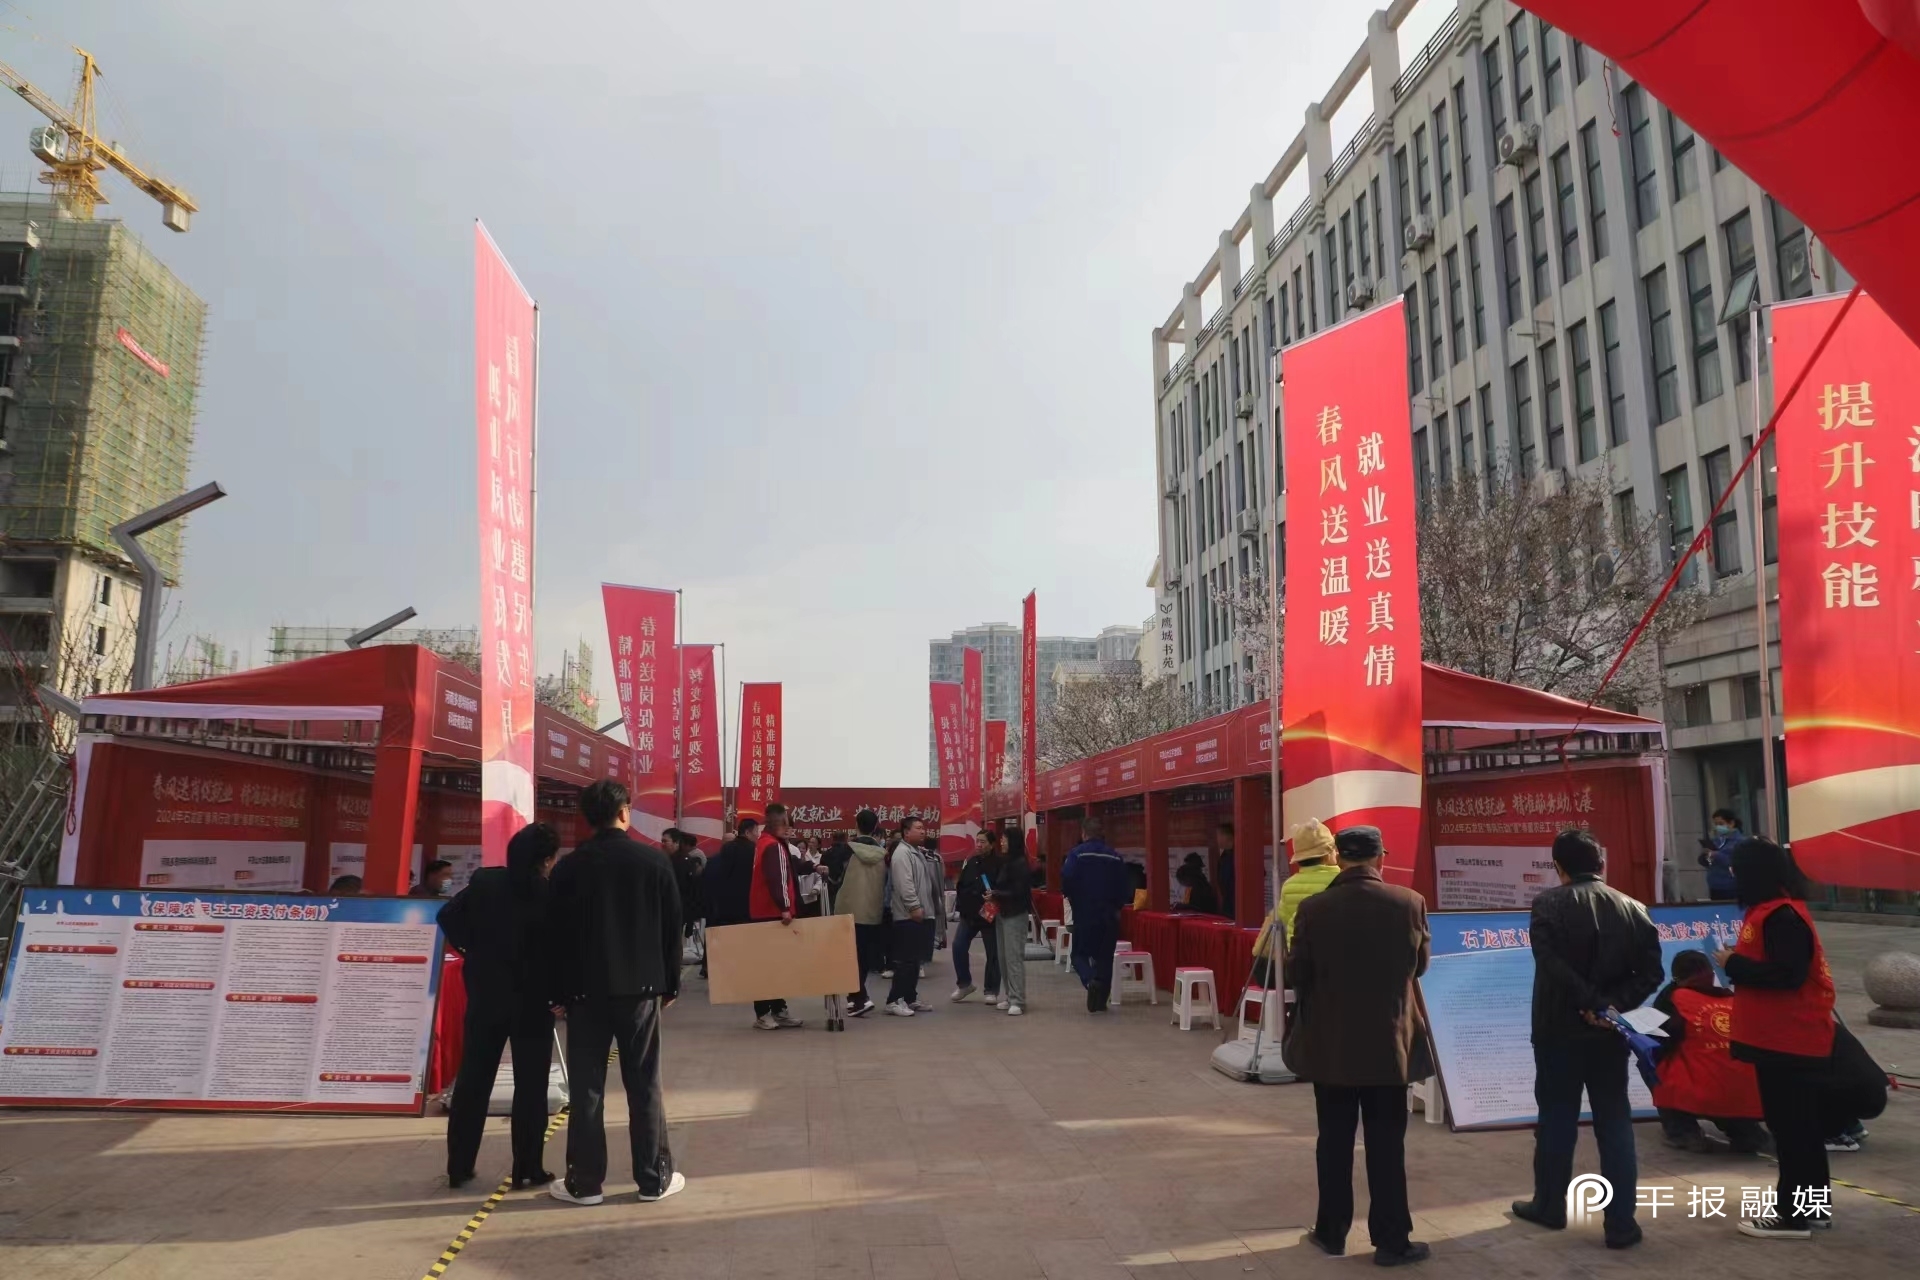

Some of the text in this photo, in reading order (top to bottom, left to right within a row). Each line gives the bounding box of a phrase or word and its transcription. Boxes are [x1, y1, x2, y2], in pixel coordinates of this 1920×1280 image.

[1316, 404, 1351, 646] 春风送温暖
[1817, 381, 1880, 609] 提升技能
[1356, 432, 1396, 687] 就业送真情
[1161, 617, 1174, 669] 鹰城书苑
[751, 701, 762, 801] 春风送岗促就业
[765, 713, 776, 804] 精准服务助发
[140, 900, 330, 921] 《保障农民工工资支付条例》
